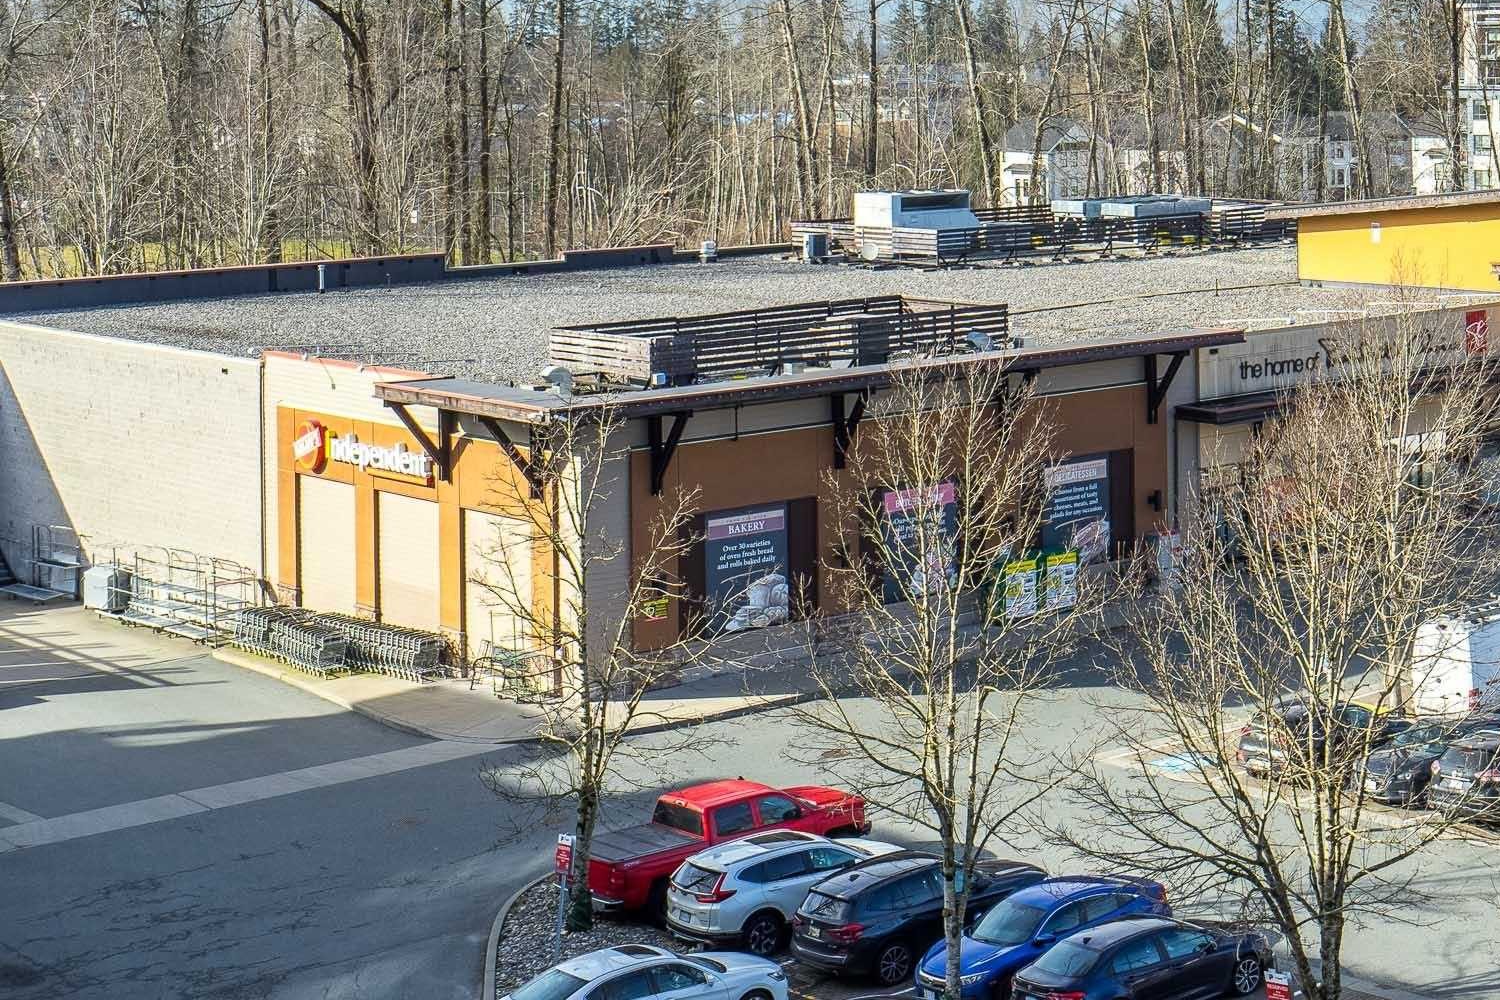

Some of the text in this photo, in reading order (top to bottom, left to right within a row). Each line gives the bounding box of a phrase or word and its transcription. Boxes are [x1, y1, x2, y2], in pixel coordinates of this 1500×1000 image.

[1239, 351, 1321, 380] the home of
[728, 520, 766, 535] BAKERY
[722, 539, 771, 552] Over 30 varieties
[742, 549, 757, 558] fresh
[757, 546, 774, 555] bread
[717, 554, 777, 570] and rolls baked daily
